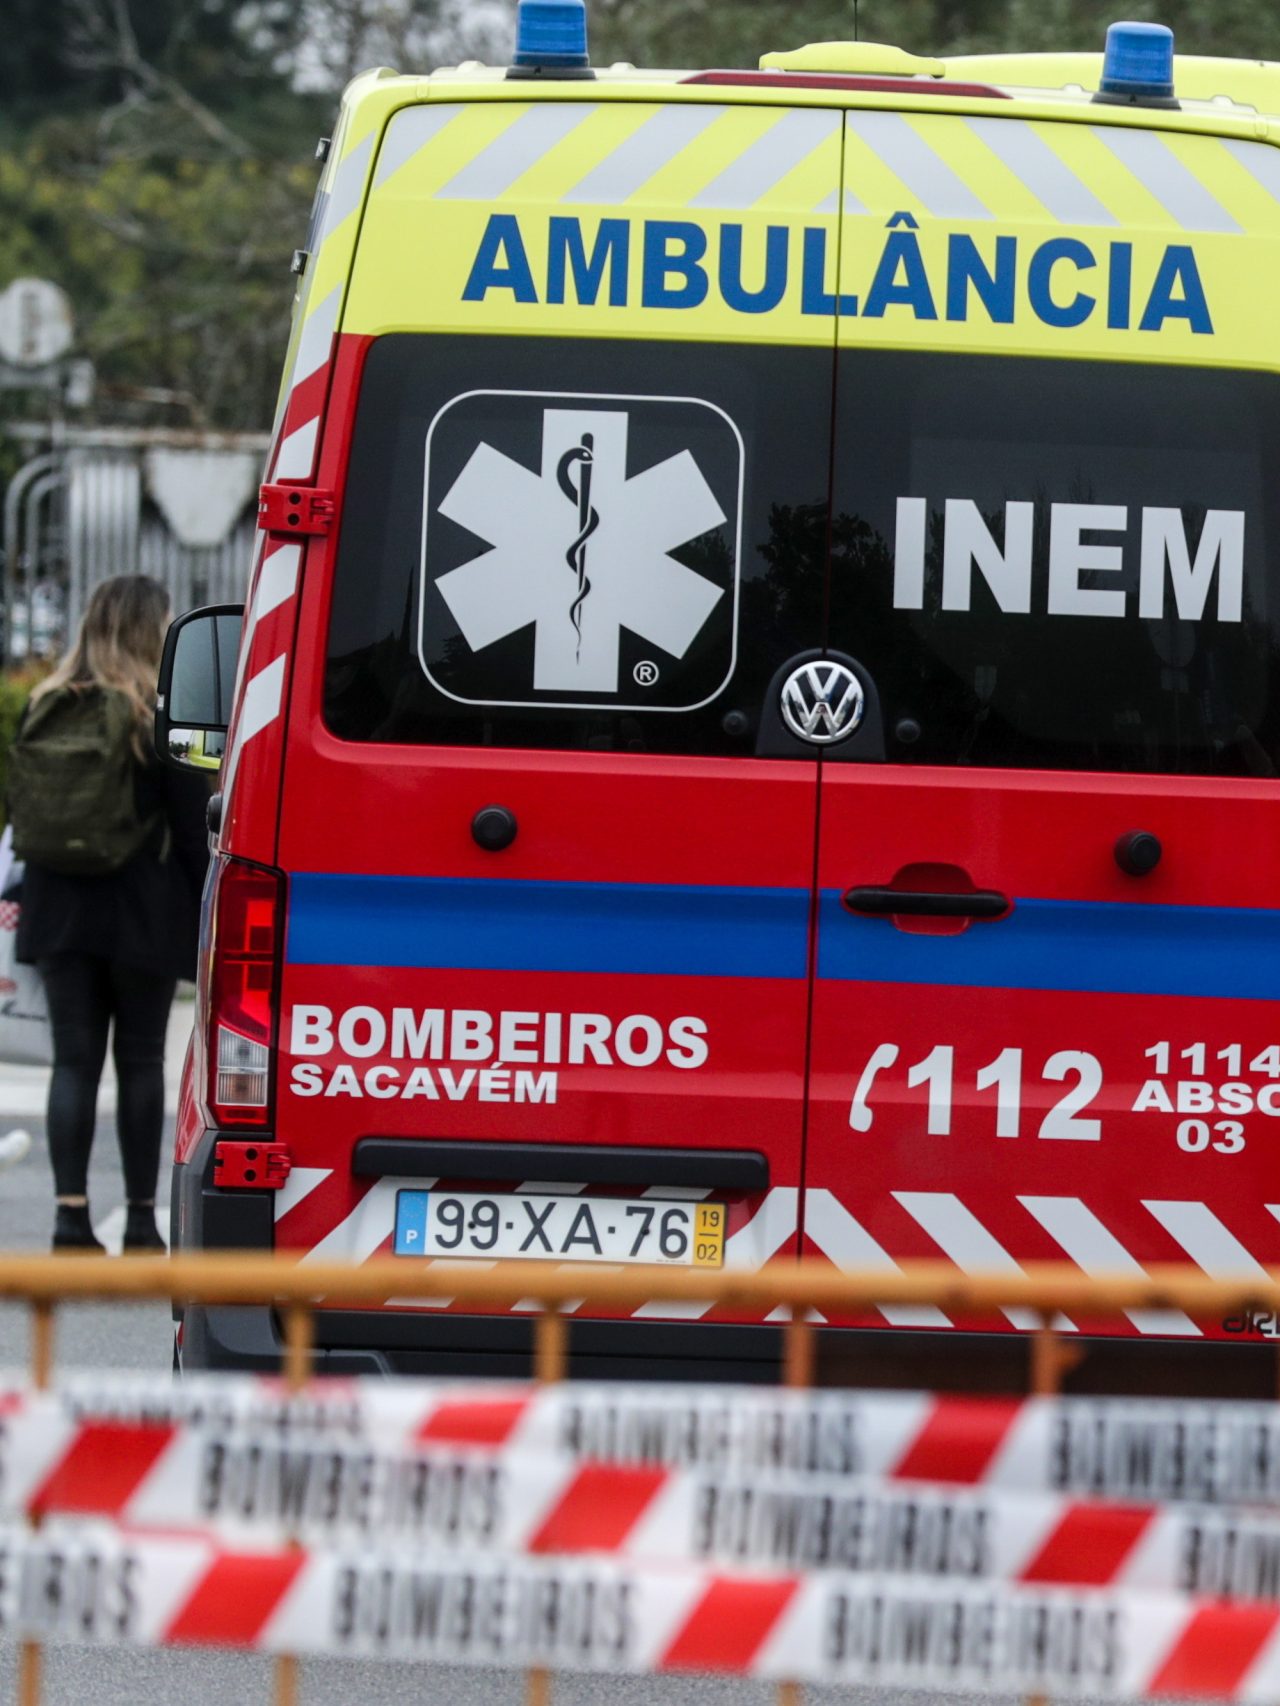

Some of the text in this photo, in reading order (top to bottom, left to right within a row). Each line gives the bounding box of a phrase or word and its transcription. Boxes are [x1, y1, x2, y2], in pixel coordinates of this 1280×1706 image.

[461, 212, 1214, 335] AMBULÂNCIA
[893, 497, 1245, 623] INEM
[290, 1004, 709, 1069] BOMBEIROS
[289, 1062, 558, 1104] SACAVÉM
[907, 1044, 1104, 1141] 112
[1175, 1120, 1246, 1154] 03
[405, 1230, 418, 1244] P
[702, 1210, 720, 1227] 19
[697, 1243, 718, 1261] 02
